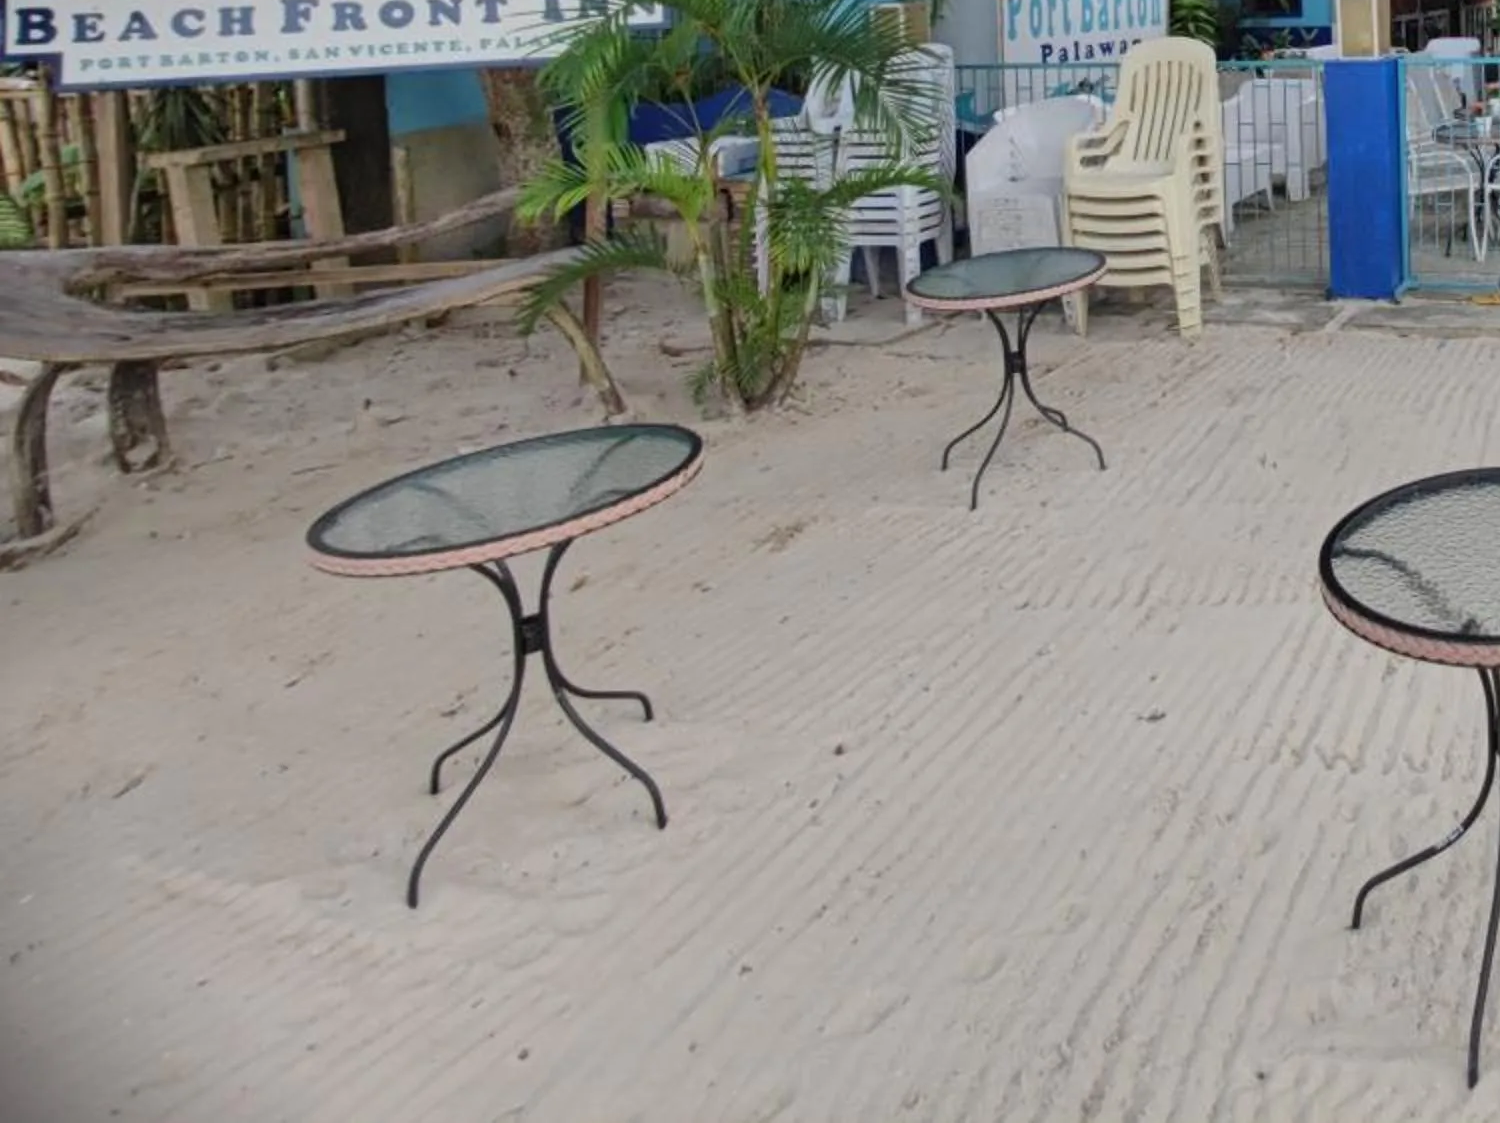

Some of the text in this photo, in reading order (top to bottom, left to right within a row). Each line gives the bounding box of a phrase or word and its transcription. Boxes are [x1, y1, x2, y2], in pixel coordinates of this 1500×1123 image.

[14, 6, 256, 46] BEACH
[79, 53, 152, 72] PORT
[287, 45, 340, 61] SAN
[1040, 38, 1142, 64] Palawa
